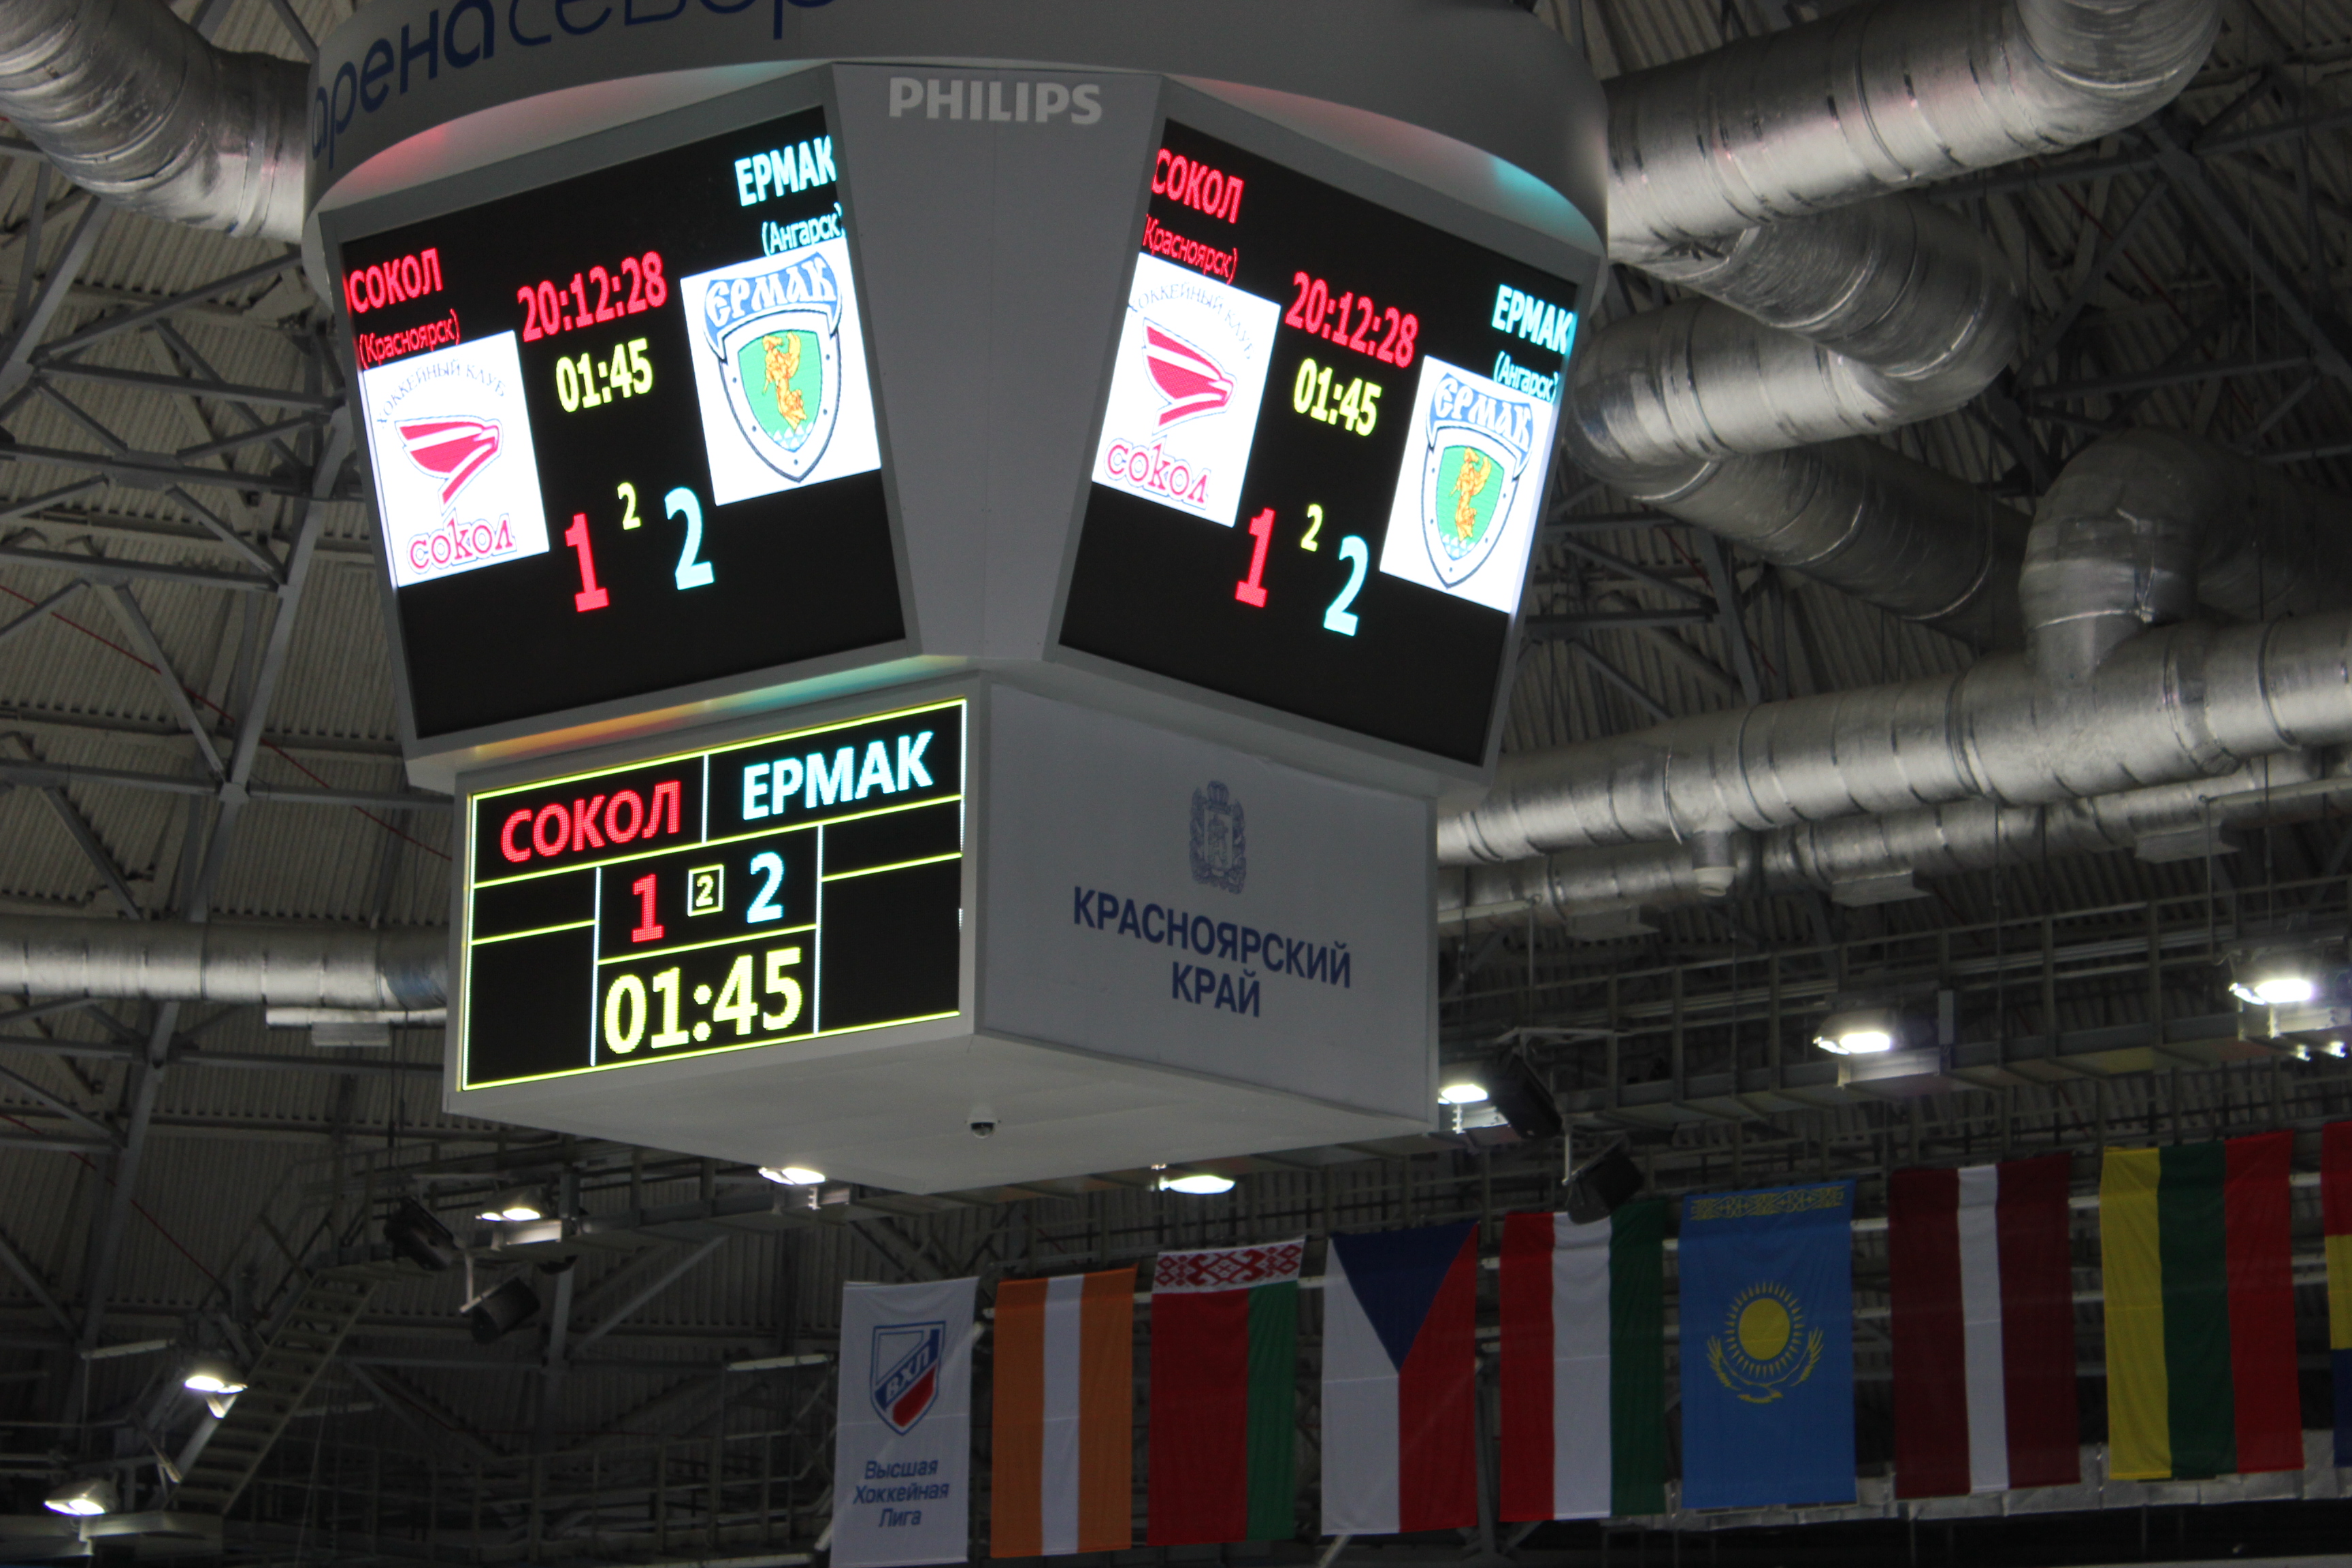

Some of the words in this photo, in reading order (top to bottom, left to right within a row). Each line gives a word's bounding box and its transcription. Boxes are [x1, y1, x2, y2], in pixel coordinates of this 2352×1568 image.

[889, 77, 1102, 125] PHILIPS
[734, 135, 837, 206] ЕРМАК
[1151, 148, 1245, 224] СОКОЛ
[349, 248, 443, 314] СОКОЛ
[1142, 213, 1238, 285] Красноярск)
[517, 250, 668, 342] 20:12:28
[1284, 271, 1419, 368] 20:12:28
[1492, 284, 1573, 355] ЕРМАК
[359, 308, 461, 370] (Красноярск)
[555, 338, 653, 412] 01:45
[466, 363, 507, 397] КЛУБ
[1293, 357, 1382, 436] 01:45
[564, 512, 610, 612] 1
[617, 481, 641, 530] 2
[664, 486, 715, 591] 2
[1234, 507, 1275, 608] 1
[1300, 503, 1324, 552] 2
[1323, 535, 1369, 636] 2
[742, 730, 934, 821] ЕРМАК
[500, 780, 681, 864] СОКОЛ
[632, 873, 665, 943] 1
[696, 874, 713, 908] 2
[747, 851, 785, 924] 2
[1073, 886, 1350, 989] КРАСНОЯРСКИЙ
[604, 947, 803, 1055] 01:45
[1172, 961, 1260, 1017] КРАЙ
[885, 1345, 930, 1404] ВХЛ
[852, 1482, 950, 1505] Хоккейная
[864, 1459, 938, 1480] Высшая
[878, 1507, 922, 1527] Лига
